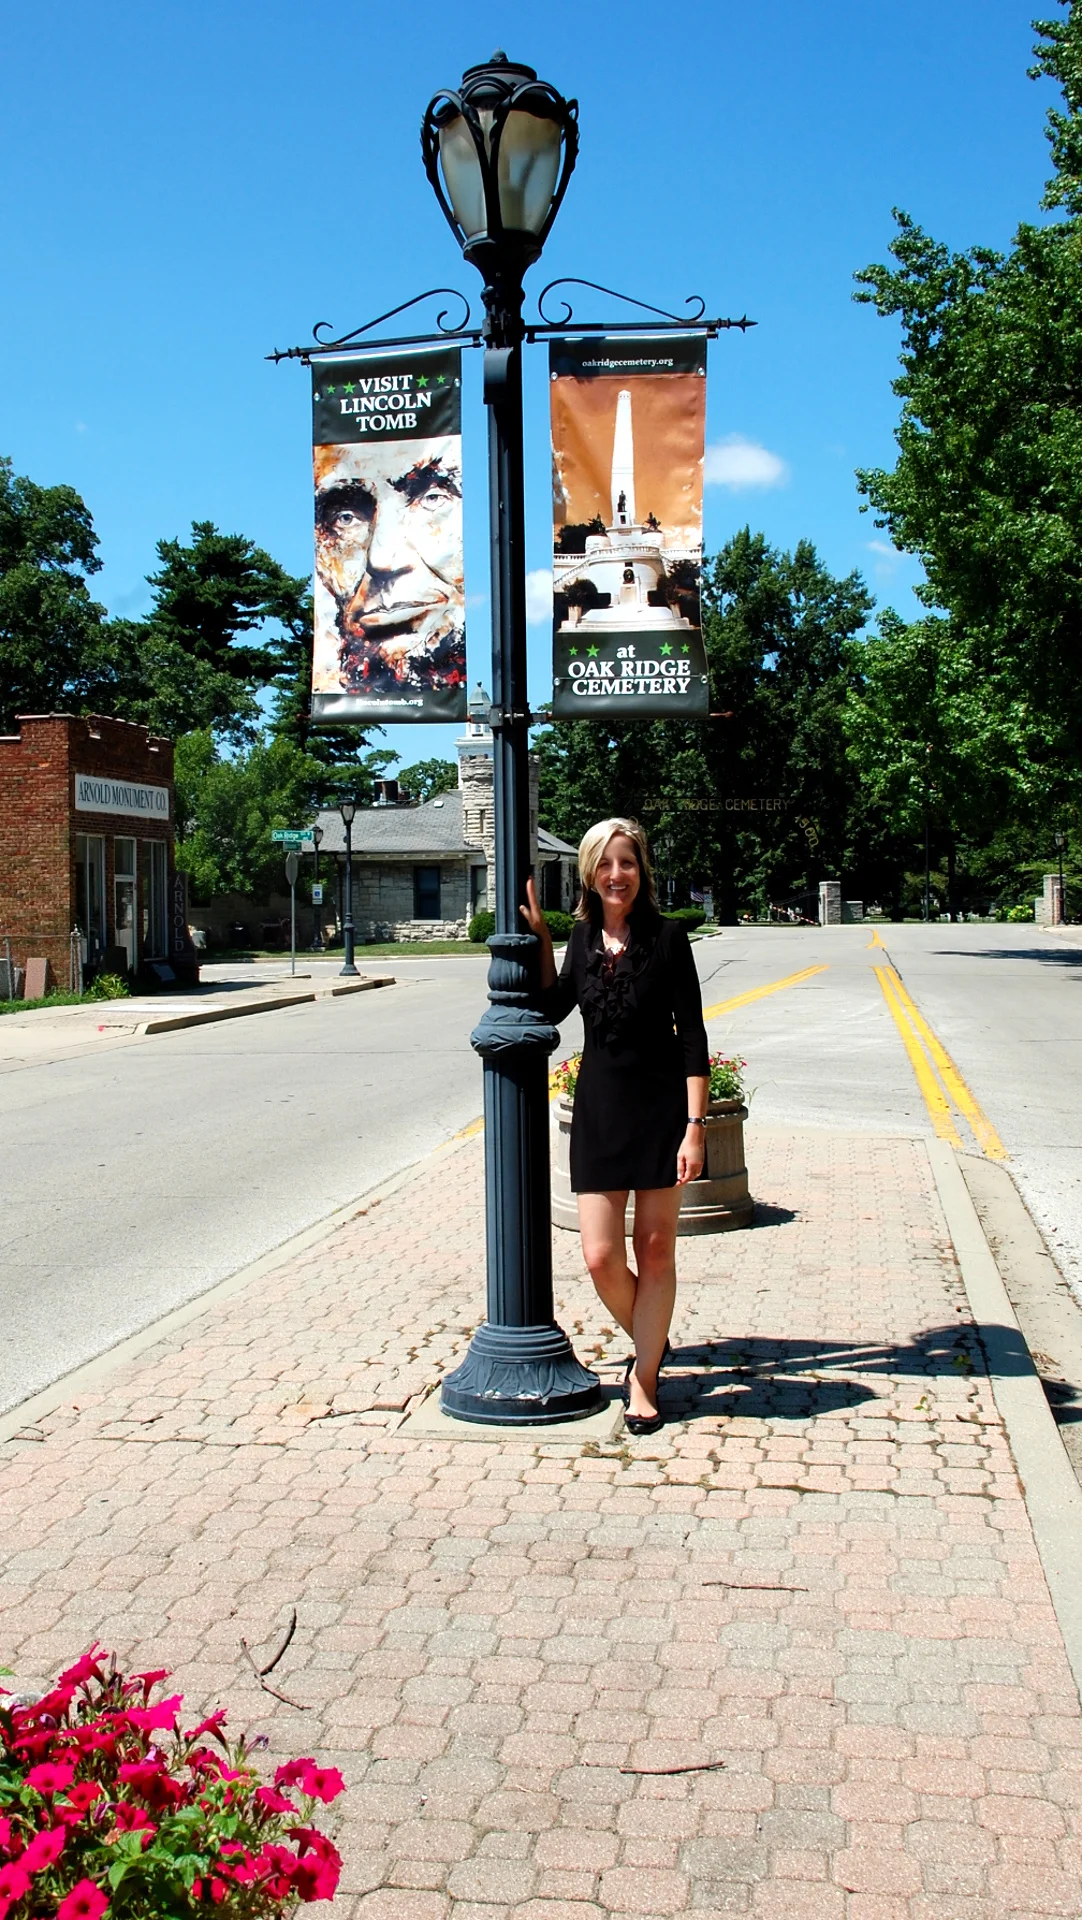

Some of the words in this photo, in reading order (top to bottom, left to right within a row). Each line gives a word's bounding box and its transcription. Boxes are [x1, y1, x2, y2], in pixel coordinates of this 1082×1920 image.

[582, 358, 674, 368] oakridgecemetery.org
[359, 374, 414, 394] VISIT
[340, 391, 433, 414] LINCOLN
[356, 413, 418, 432] TOMB
[616, 644, 636, 659] at
[568, 661, 615, 678] OAK
[620, 659, 691, 677] RIDGE
[572, 677, 691, 695] CEMETERY
[78, 781, 111, 804] ARNOLD
[112, 785, 154, 809] MONUMENT
[155, 791, 167, 811] CO.
[724, 798, 790, 811] CEMETERY
[174, 874, 184, 952] ARNOLD
